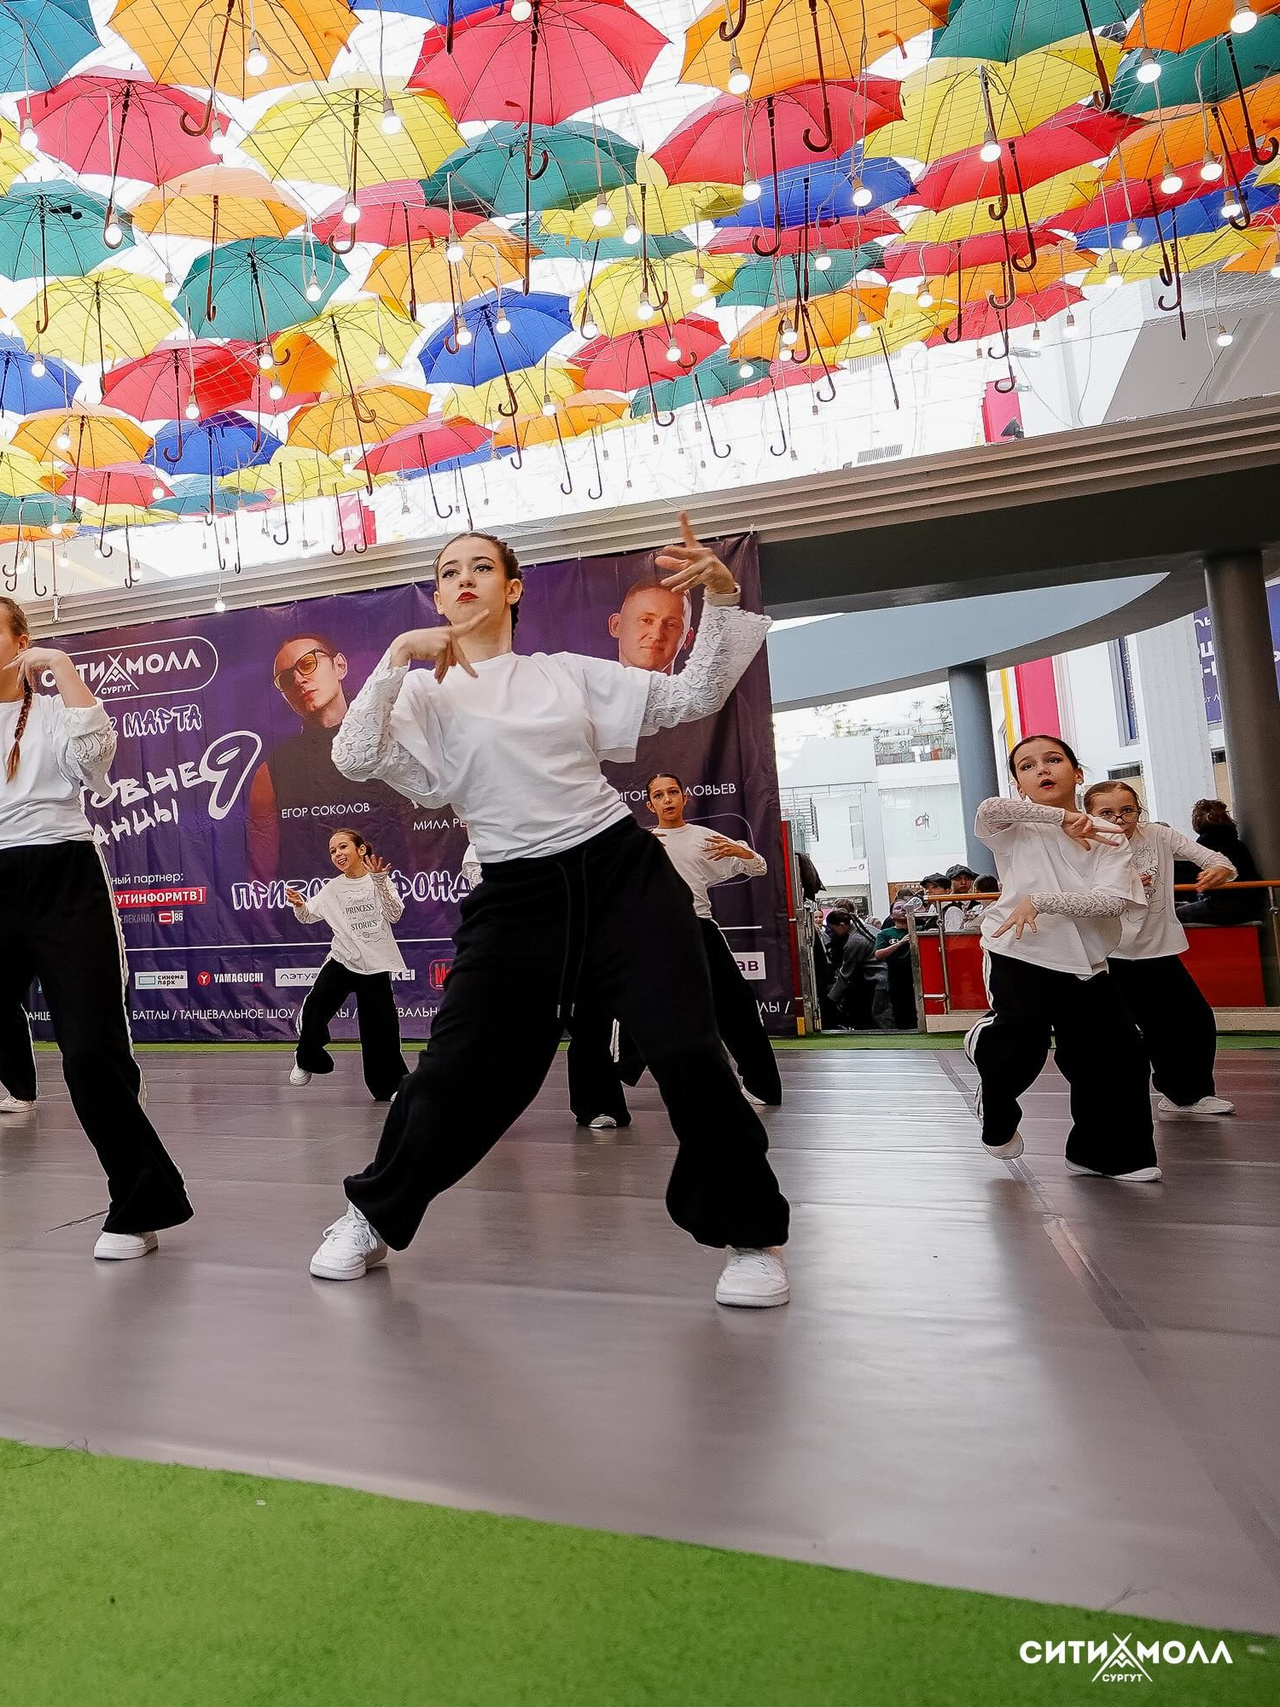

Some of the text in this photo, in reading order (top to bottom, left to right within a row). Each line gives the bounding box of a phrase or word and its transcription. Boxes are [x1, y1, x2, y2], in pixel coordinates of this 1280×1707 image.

[40, 648, 201, 688] СТИ МОЛЛ
[101, 684, 132, 695] СУРГУТ
[123, 703, 202, 738] МАРТА
[80, 761, 201, 813] ОВЫЕ
[684, 783, 737, 798] ЛОВЬЕВ
[281, 802, 371, 819] ЕГОР СОКОЛОВ
[92, 797, 179, 845] АНЦЫ
[413, 819, 450, 831] МИЛА
[112, 873, 184, 885] ный партнер:
[114, 888, 203, 905] УТИНФОРМТВ]
[231, 878, 332, 911] ПРИЗО
[345, 903, 375, 915] PRINCESS
[120, 913, 155, 924] ЕЛЕКАНАЛ
[351, 919, 378, 931] STORIES
[214, 972, 264, 983] YAMAGUCHI
[132, 1010, 170, 1020] БАТТЛЫ
[180, 1008, 264, 1020] ТАНЦЕВАЛЬНОЕ
[267, 1008, 296, 1019] ШОУ
